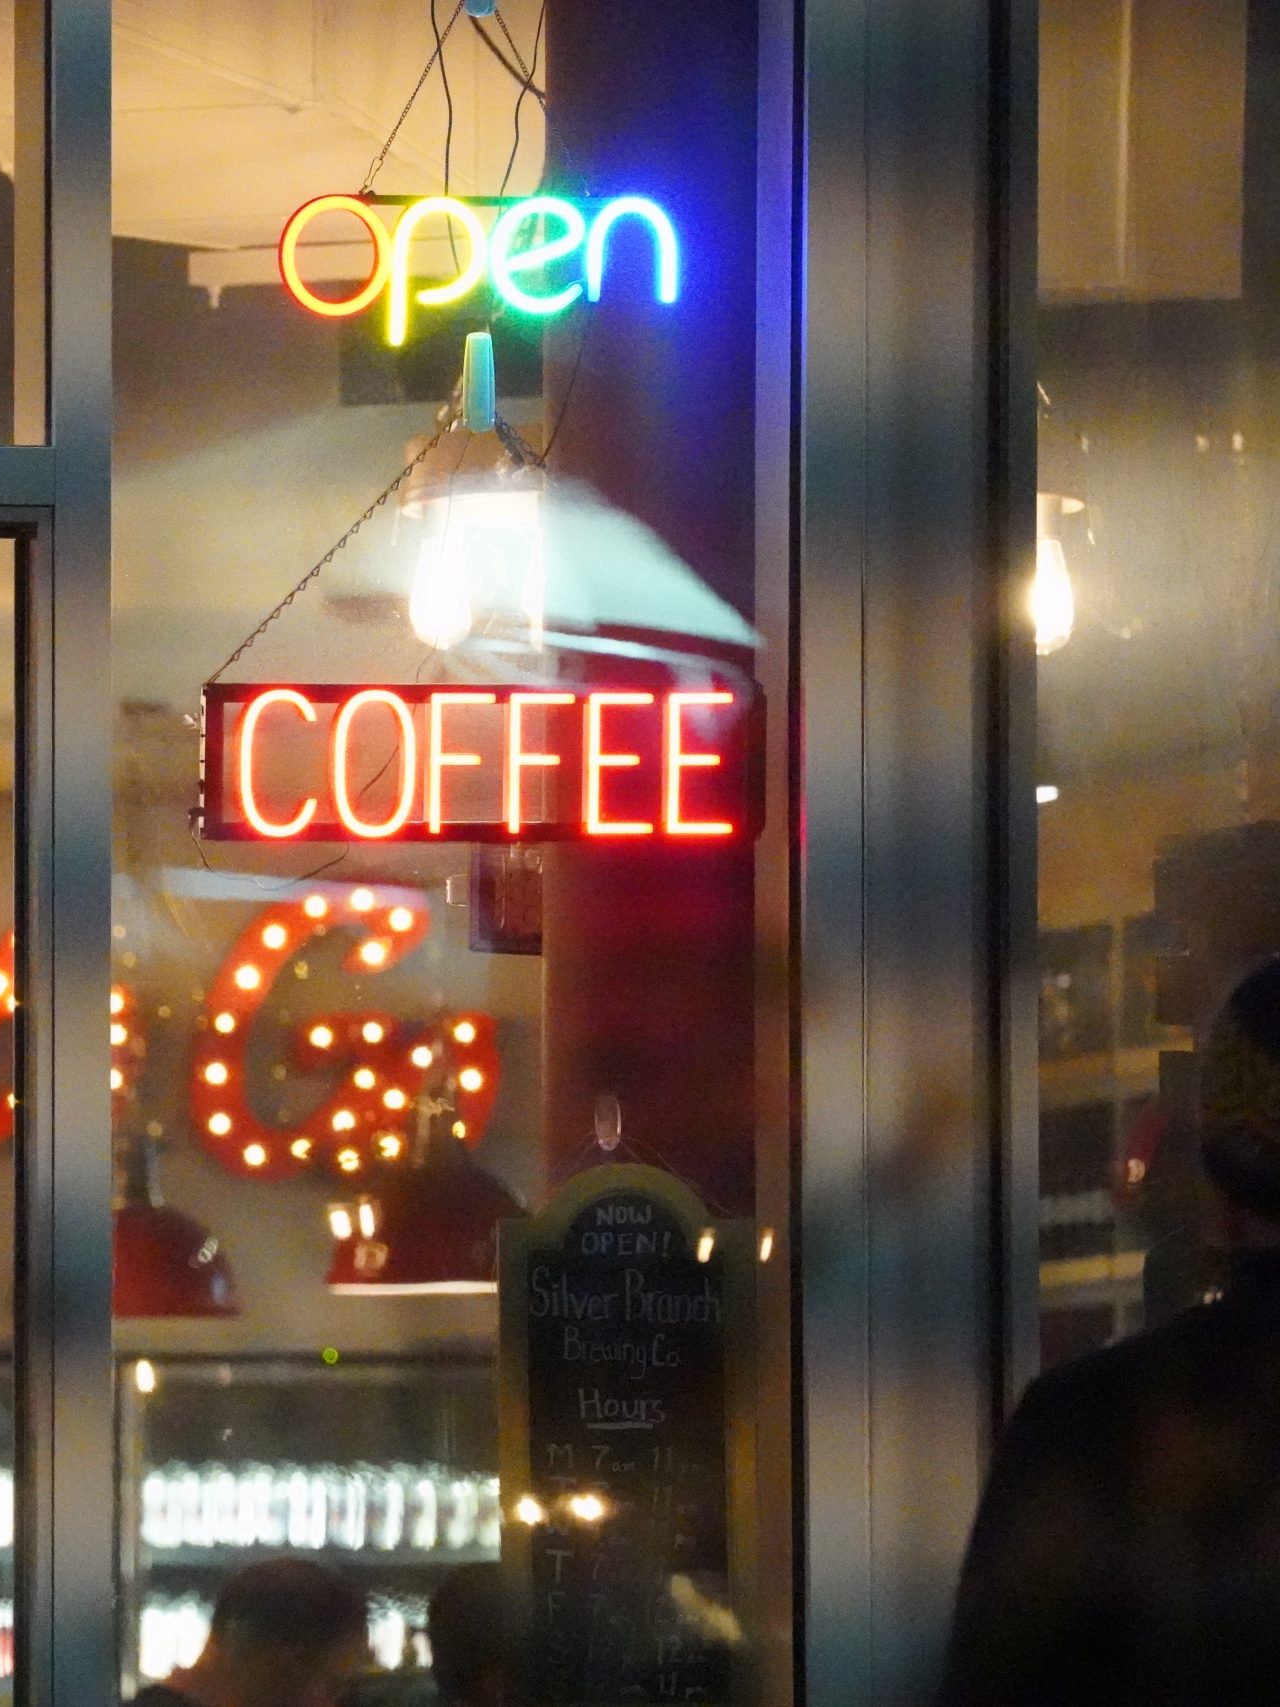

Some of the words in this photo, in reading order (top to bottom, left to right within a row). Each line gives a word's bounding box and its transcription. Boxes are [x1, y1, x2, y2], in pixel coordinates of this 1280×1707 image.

[278, 193, 681, 347] open
[235, 687, 736, 839] COFFEE
[595, 1204, 652, 1226] NOW
[581, 1230, 672, 1258] OPEN!
[529, 1264, 620, 1321] Silver
[624, 1267, 722, 1323] Branch
[563, 1324, 648, 1380] Brewing
[577, 1387, 666, 1424] Hours
